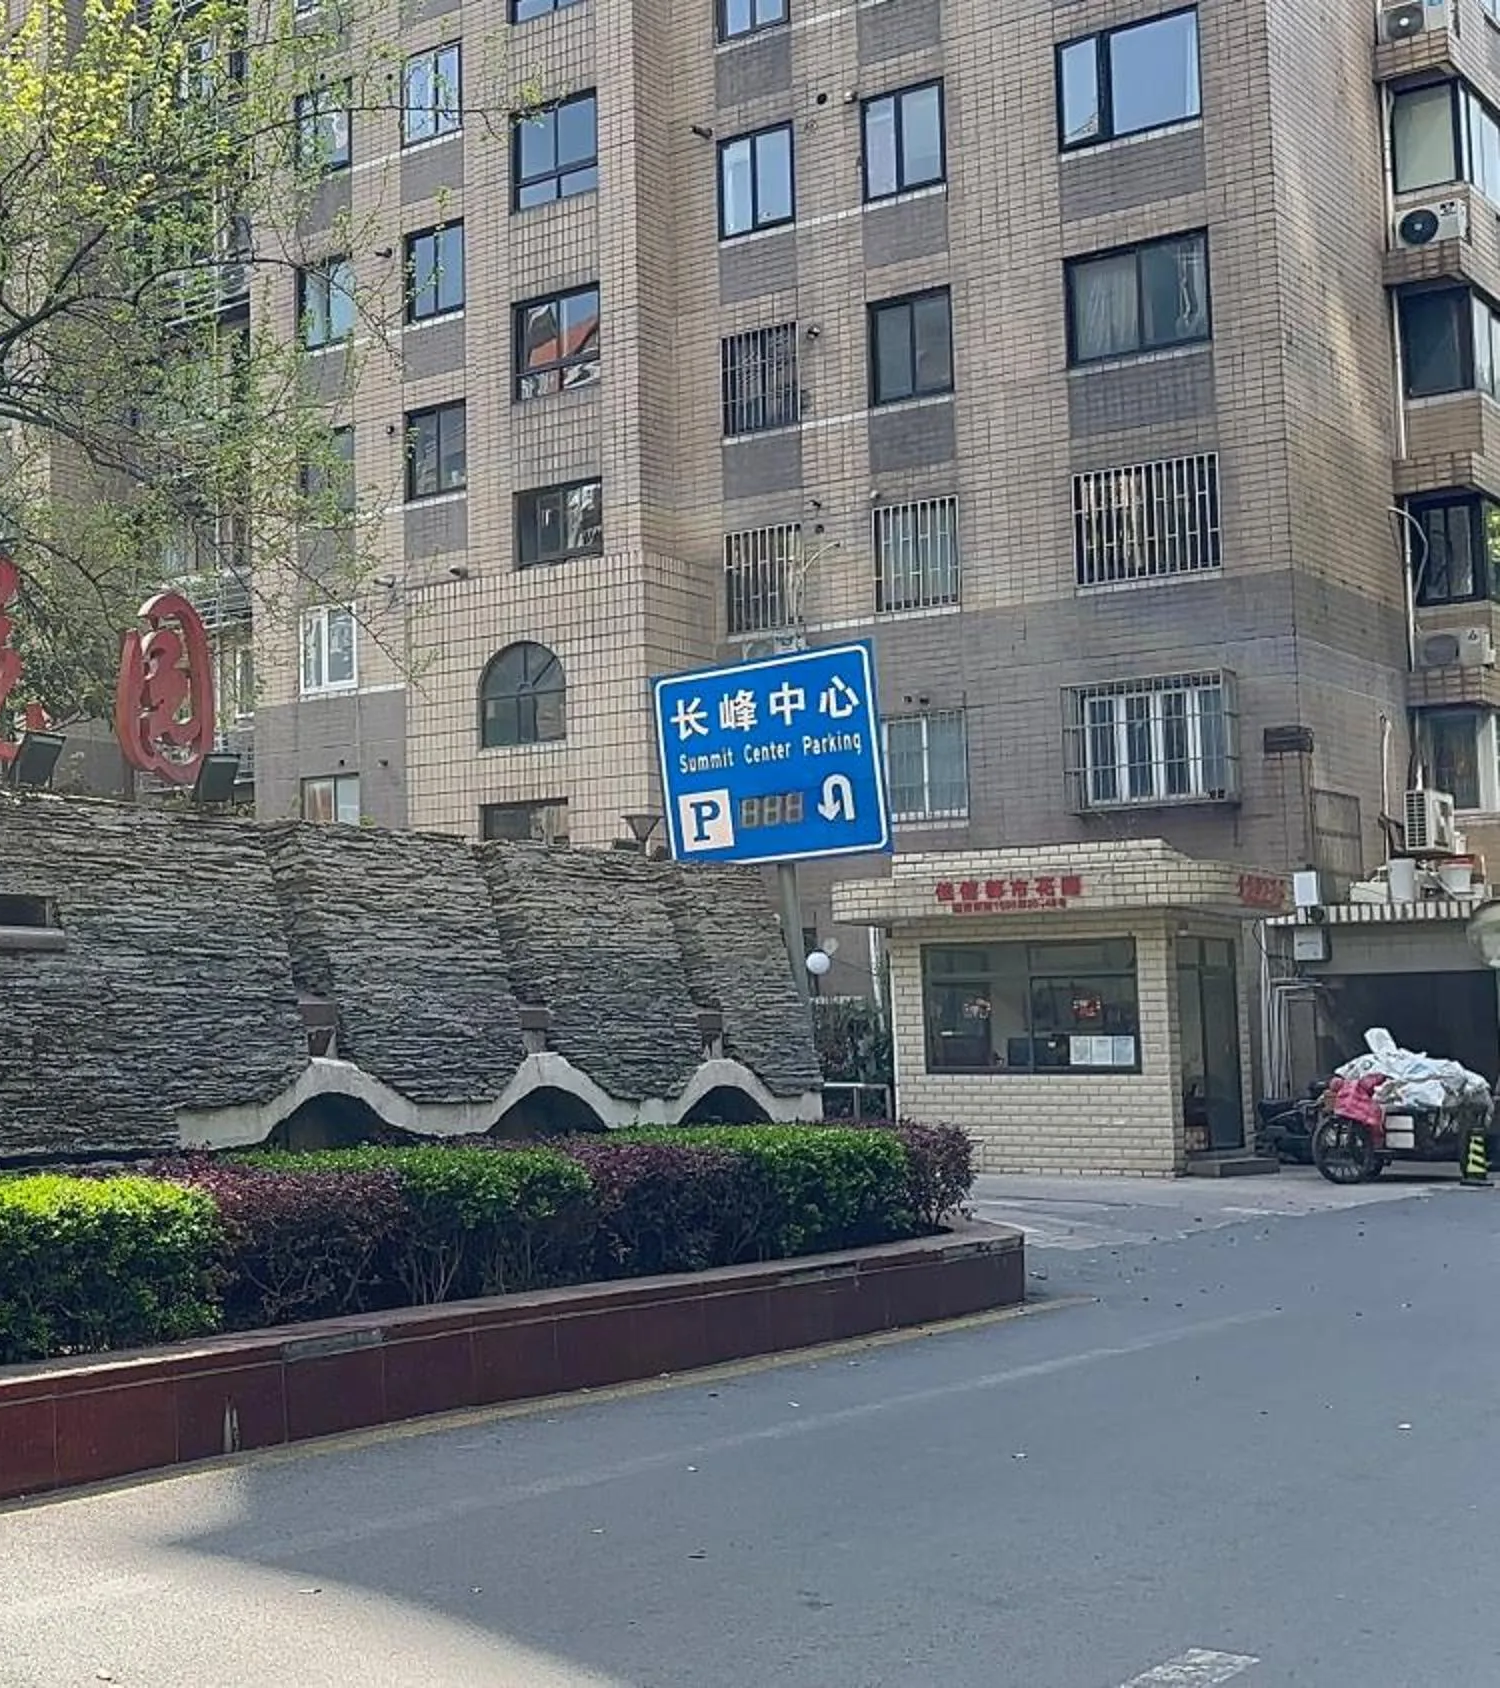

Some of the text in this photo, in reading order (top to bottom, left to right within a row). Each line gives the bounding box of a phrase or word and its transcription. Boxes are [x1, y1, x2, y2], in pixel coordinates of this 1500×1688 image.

[670, 675, 860, 741] 长峰中心
[679, 732, 862, 774] Summit Center Parking
[689, 799, 721, 842] P
